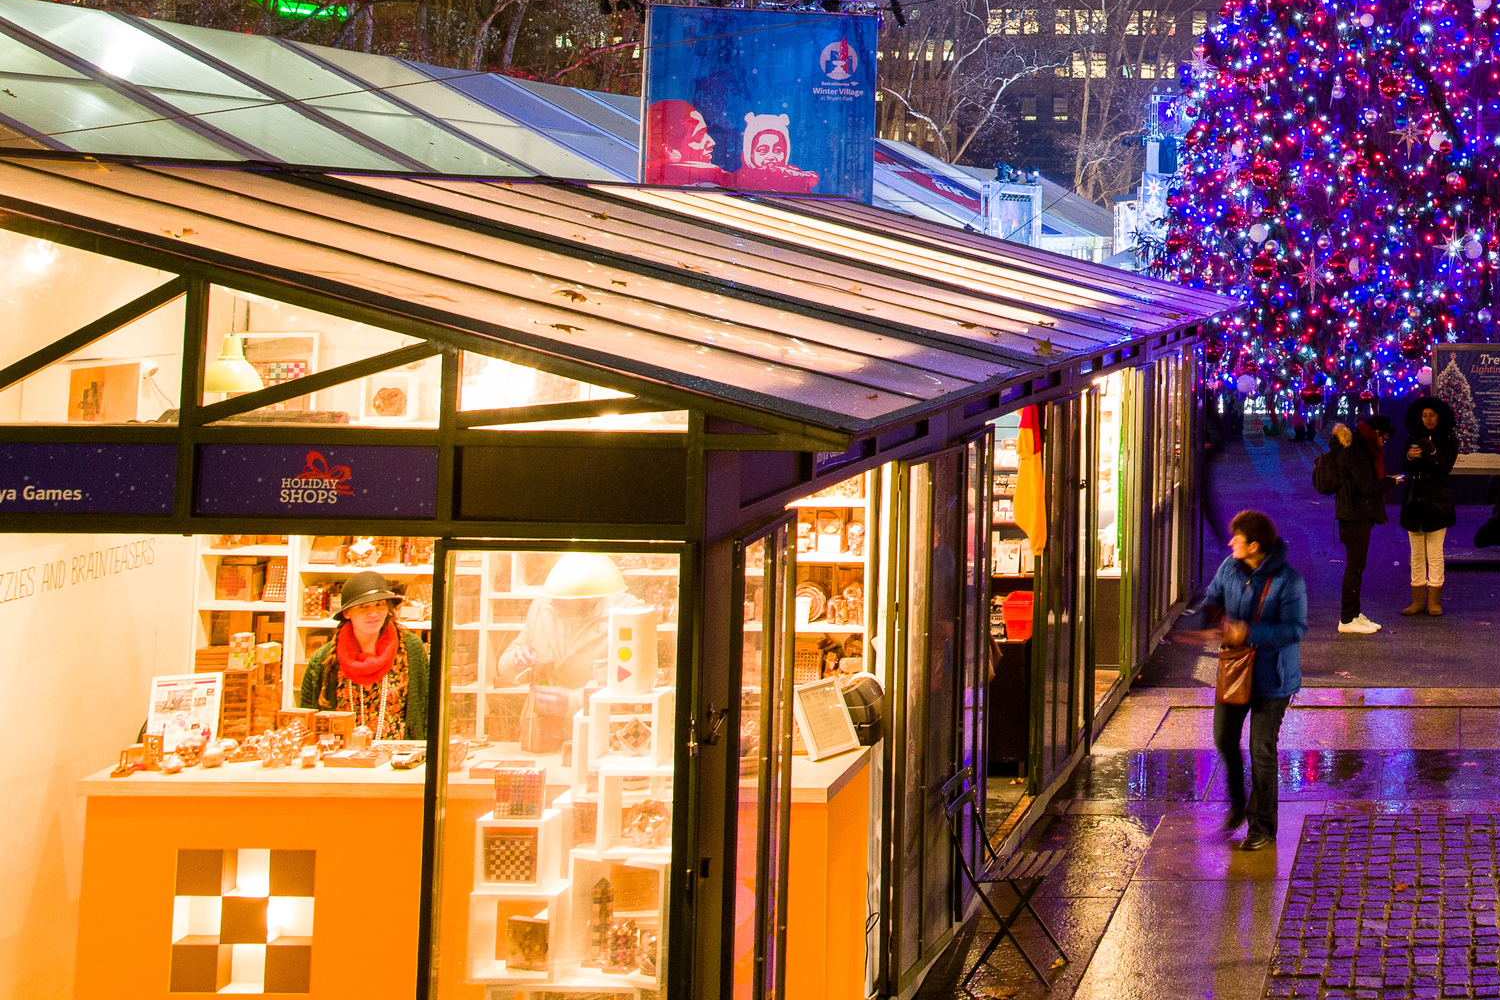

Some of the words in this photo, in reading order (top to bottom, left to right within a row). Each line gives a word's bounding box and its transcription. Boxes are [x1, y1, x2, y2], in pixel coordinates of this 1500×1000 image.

[812, 87, 838, 95] Winter
[839, 88, 864, 97] Village
[281, 477, 339, 489] HOLIDAY
[23, 485, 82, 500] Games
[279, 489, 338, 504] SHOPS
[41, 560, 66, 593] AND
[71, 537, 156, 586] BRAINTEASERS
